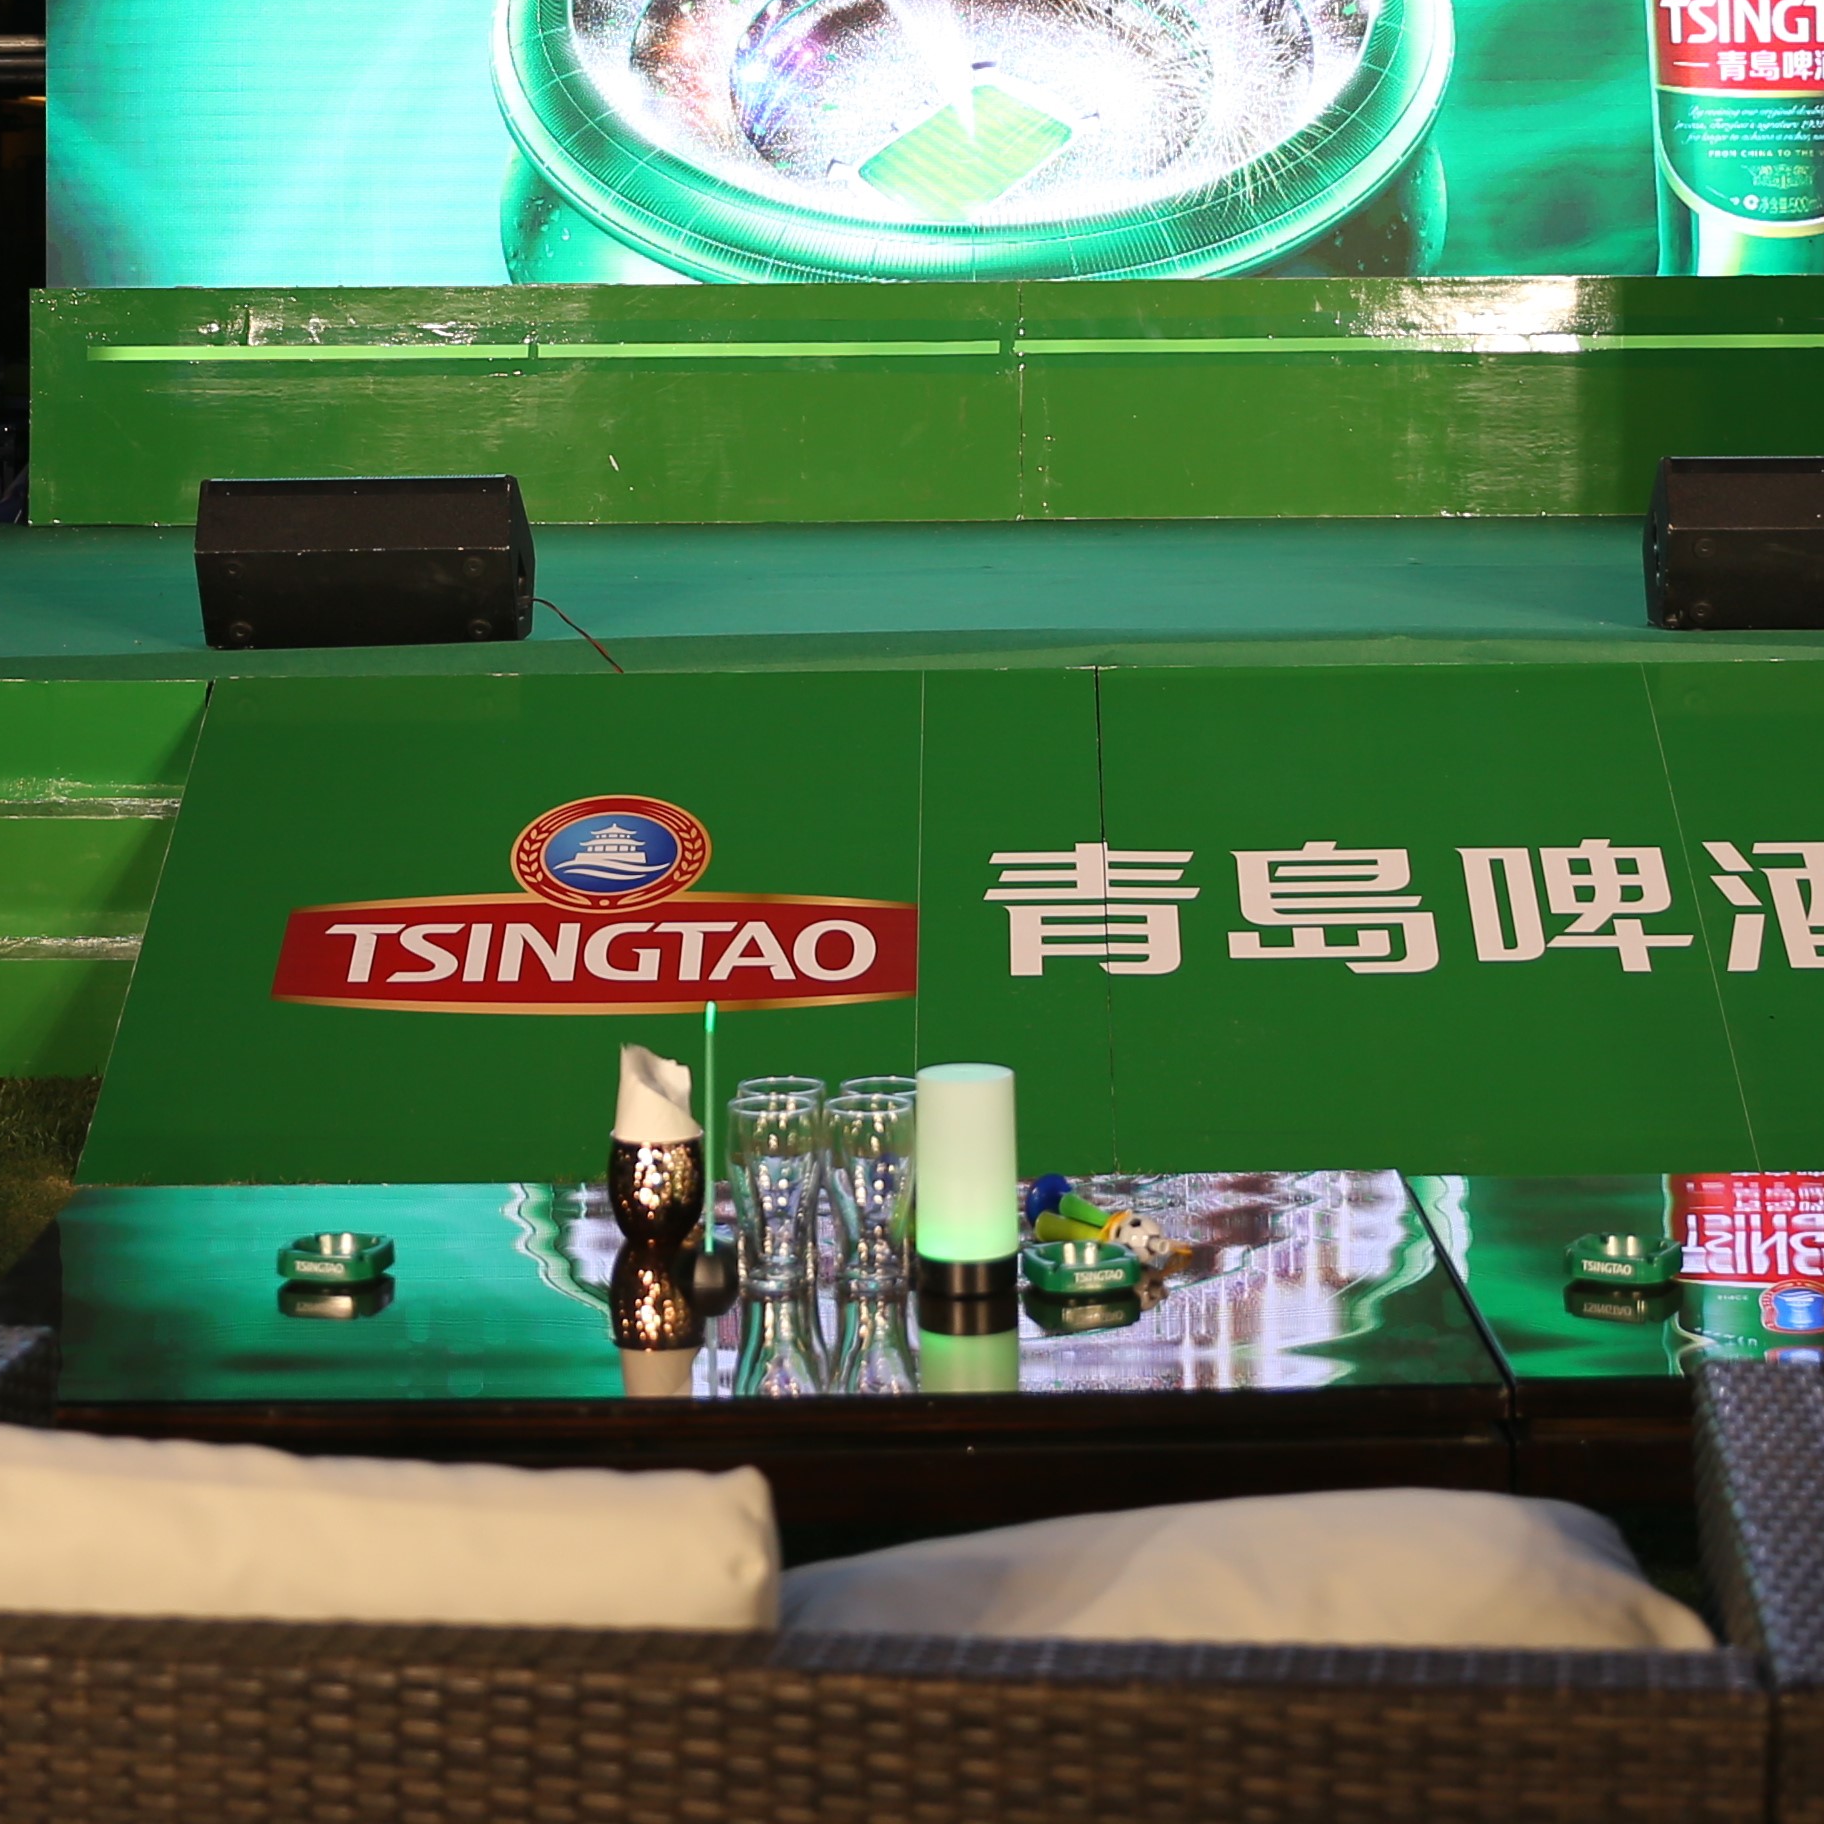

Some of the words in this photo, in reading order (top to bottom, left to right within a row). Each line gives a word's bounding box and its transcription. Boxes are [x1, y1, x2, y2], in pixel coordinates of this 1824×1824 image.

[324, 918, 879, 983] TSINGTAO
[1073, 1268, 1125, 1283] TSINGTAO
[1581, 1259, 1633, 1276] TSINGTAO
